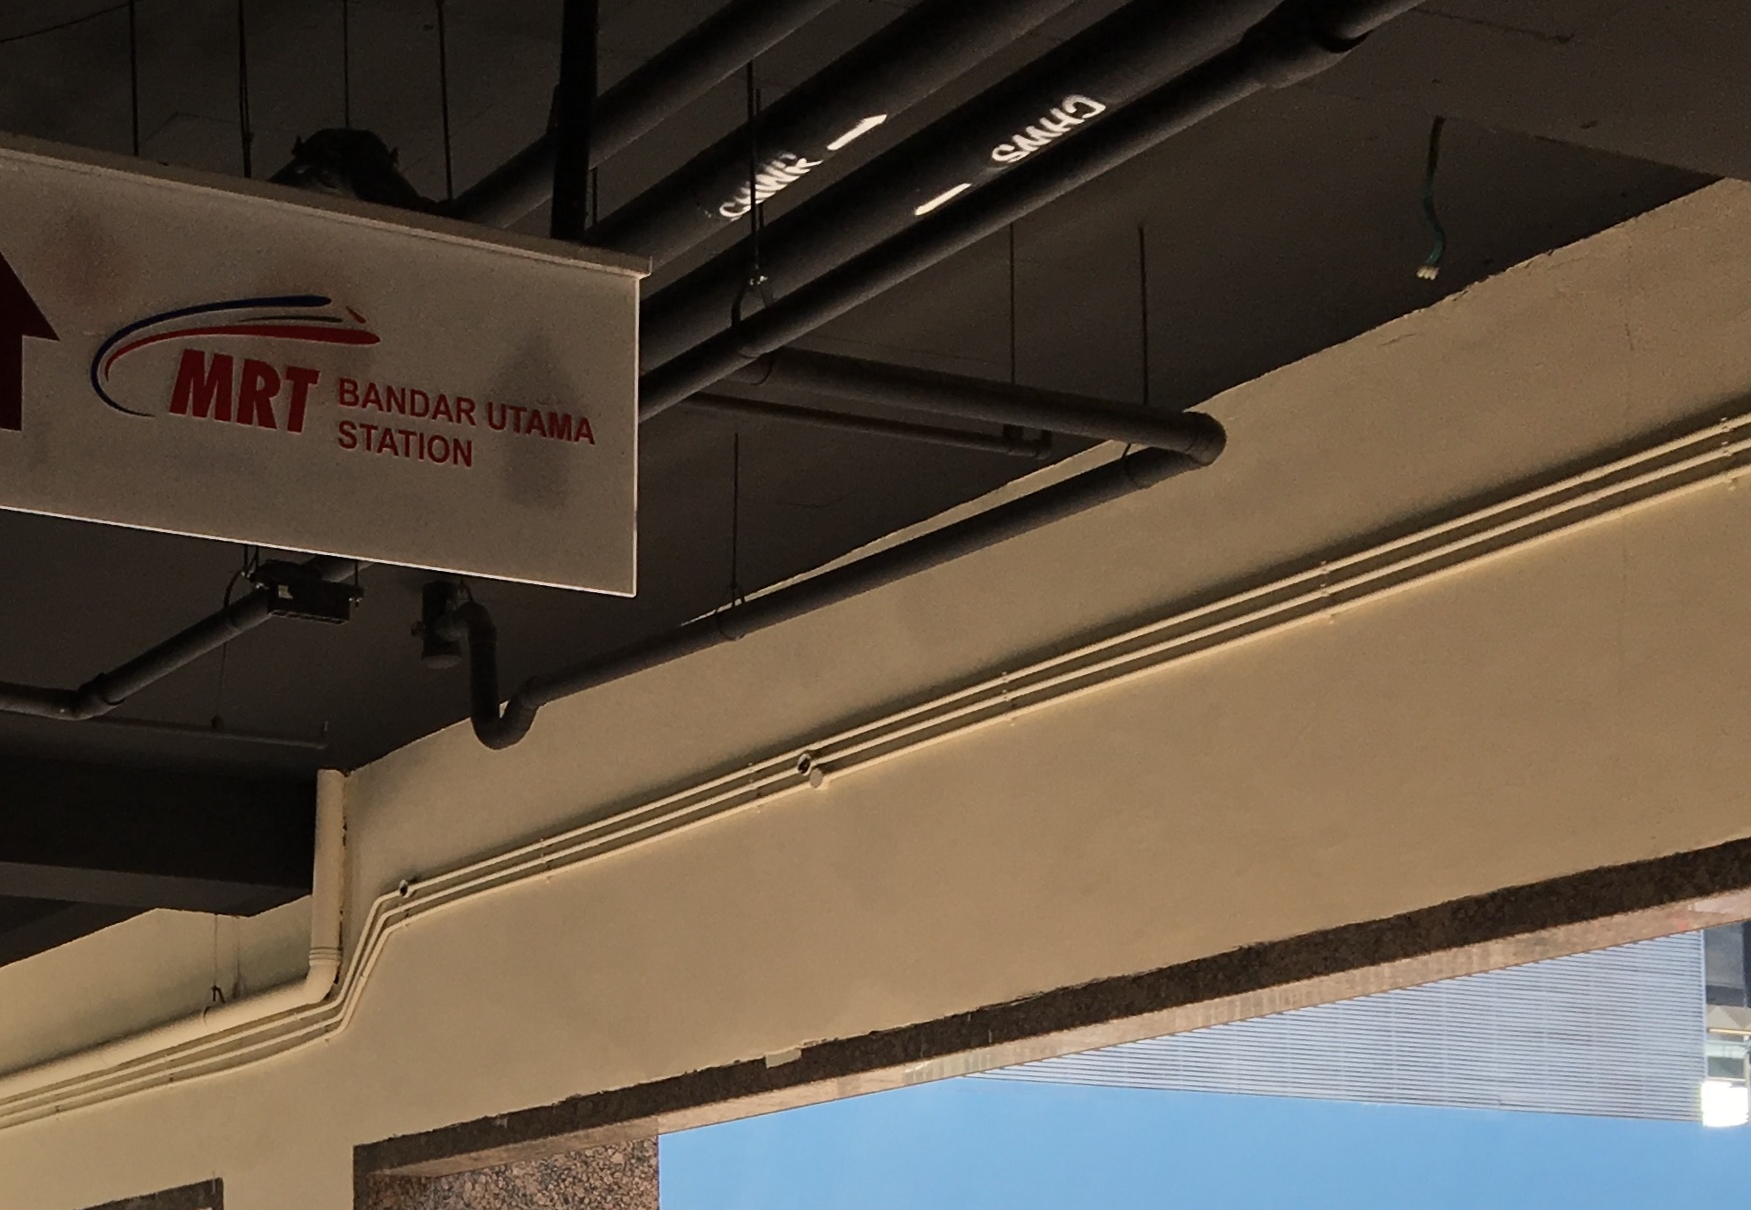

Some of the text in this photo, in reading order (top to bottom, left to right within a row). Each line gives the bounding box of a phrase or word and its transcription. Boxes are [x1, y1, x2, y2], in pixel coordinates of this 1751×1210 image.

[991, 94, 1106, 163] CHWS
[169, 349, 320, 433] MRT
[338, 378, 596, 445] BANDAR UTAMA
[338, 421, 474, 467] STATION
